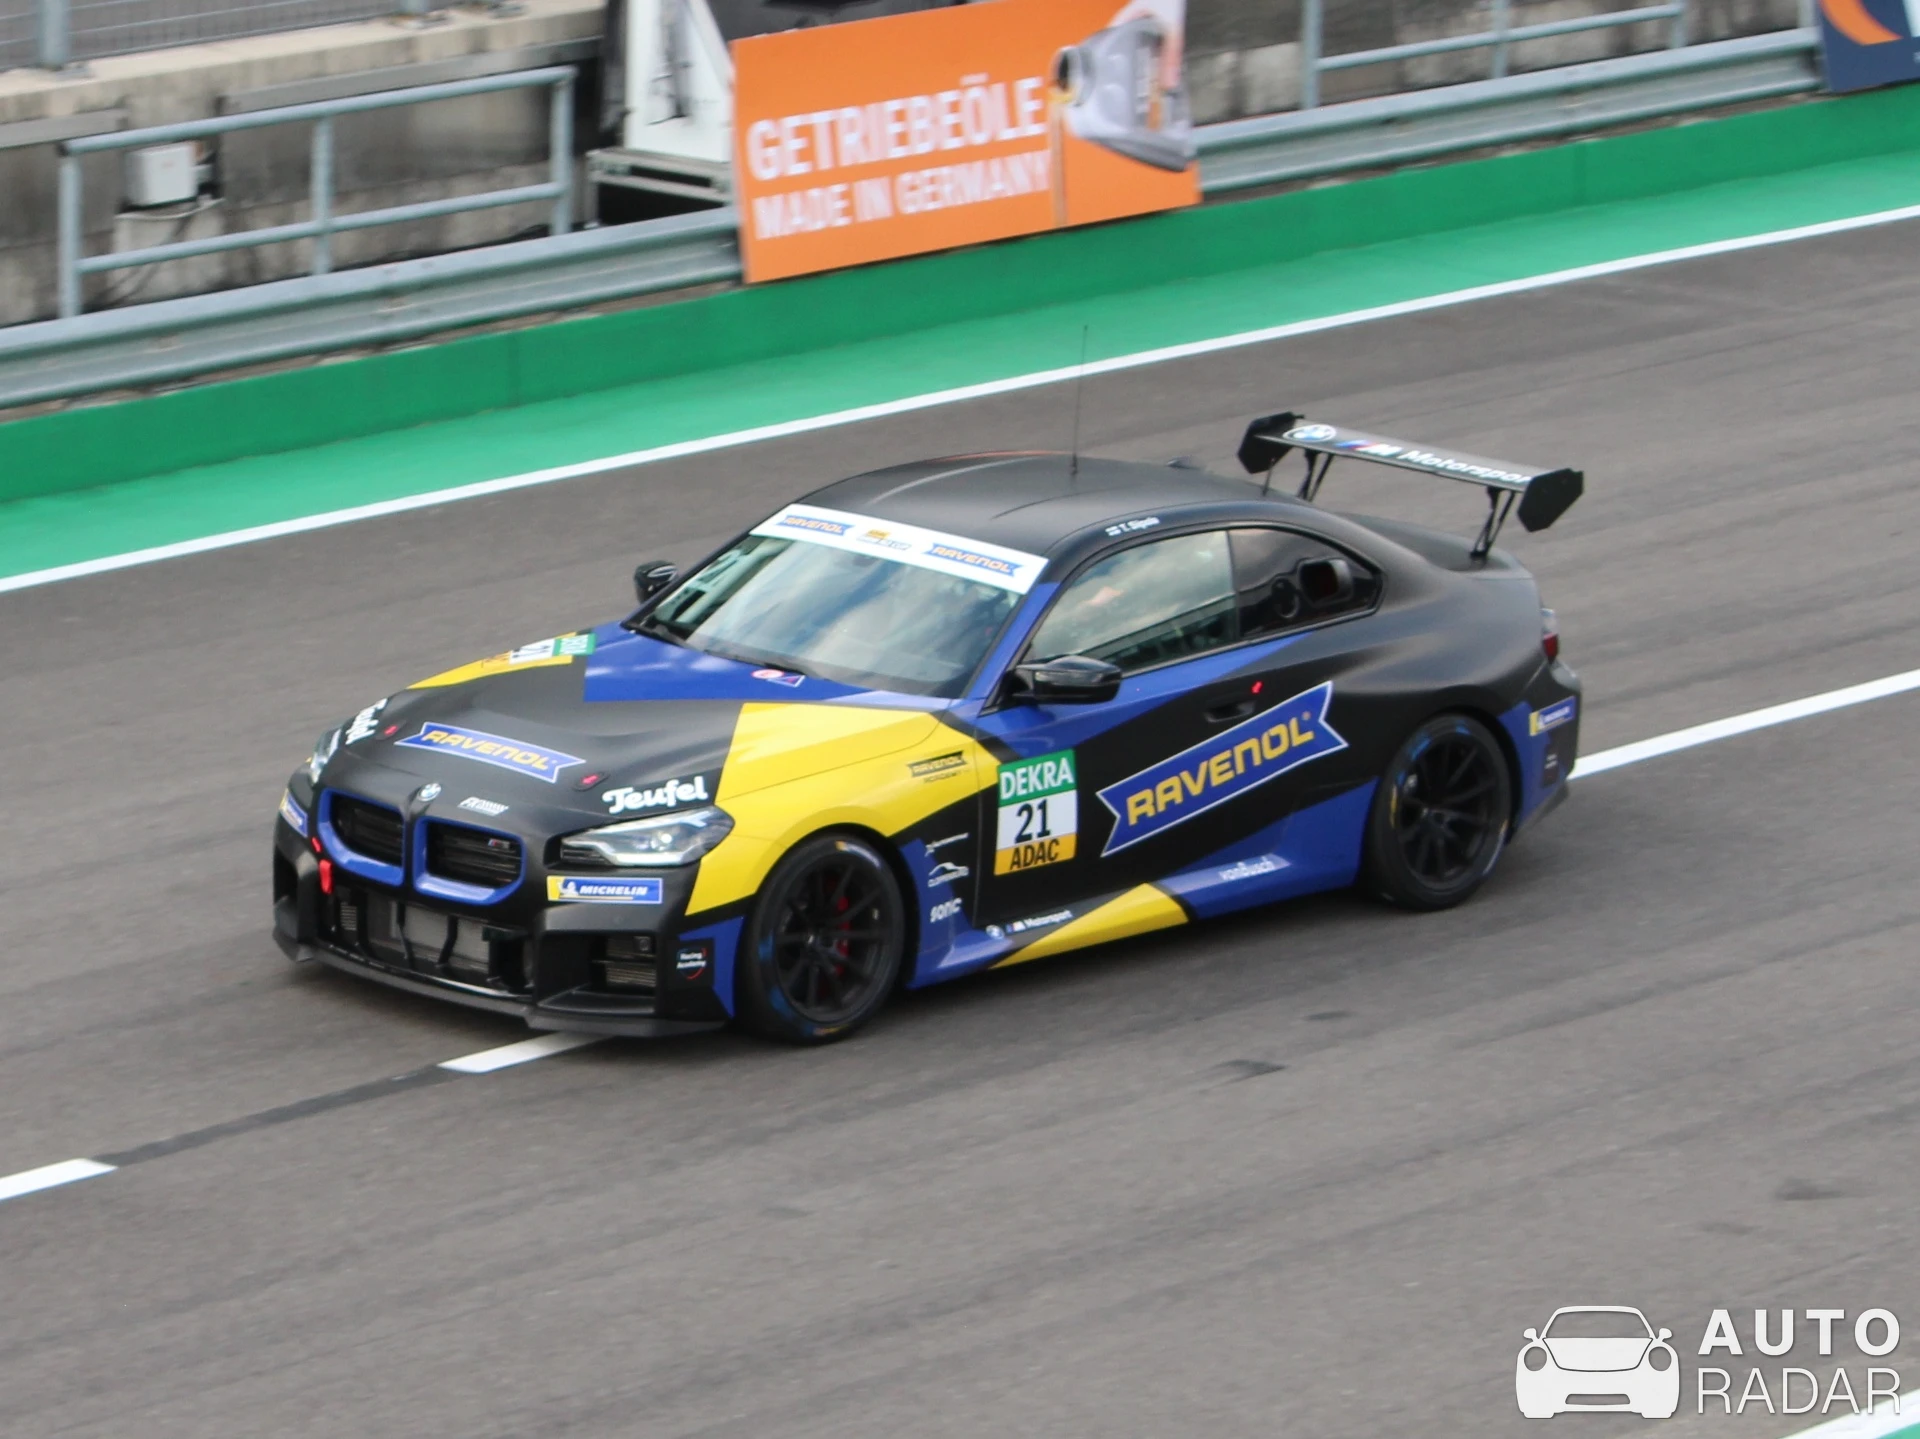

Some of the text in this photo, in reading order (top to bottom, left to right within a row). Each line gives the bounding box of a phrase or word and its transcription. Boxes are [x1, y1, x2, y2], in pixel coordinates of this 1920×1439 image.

[747, 73, 1047, 182] GETRIEBEÖLE
[754, 149, 1051, 240] MADE IN GERMANY
[1397, 450, 1532, 484] Motorspor
[421, 730, 548, 771] RAVENOL
[1126, 717, 1314, 826] RAVENOL
[602, 775, 708, 814] Teufel
[1000, 757, 1075, 800] DEKRA
[1015, 798, 1051, 845] 21
[1010, 838, 1060, 872] ADAC
[579, 885, 649, 896] MICHELIN
